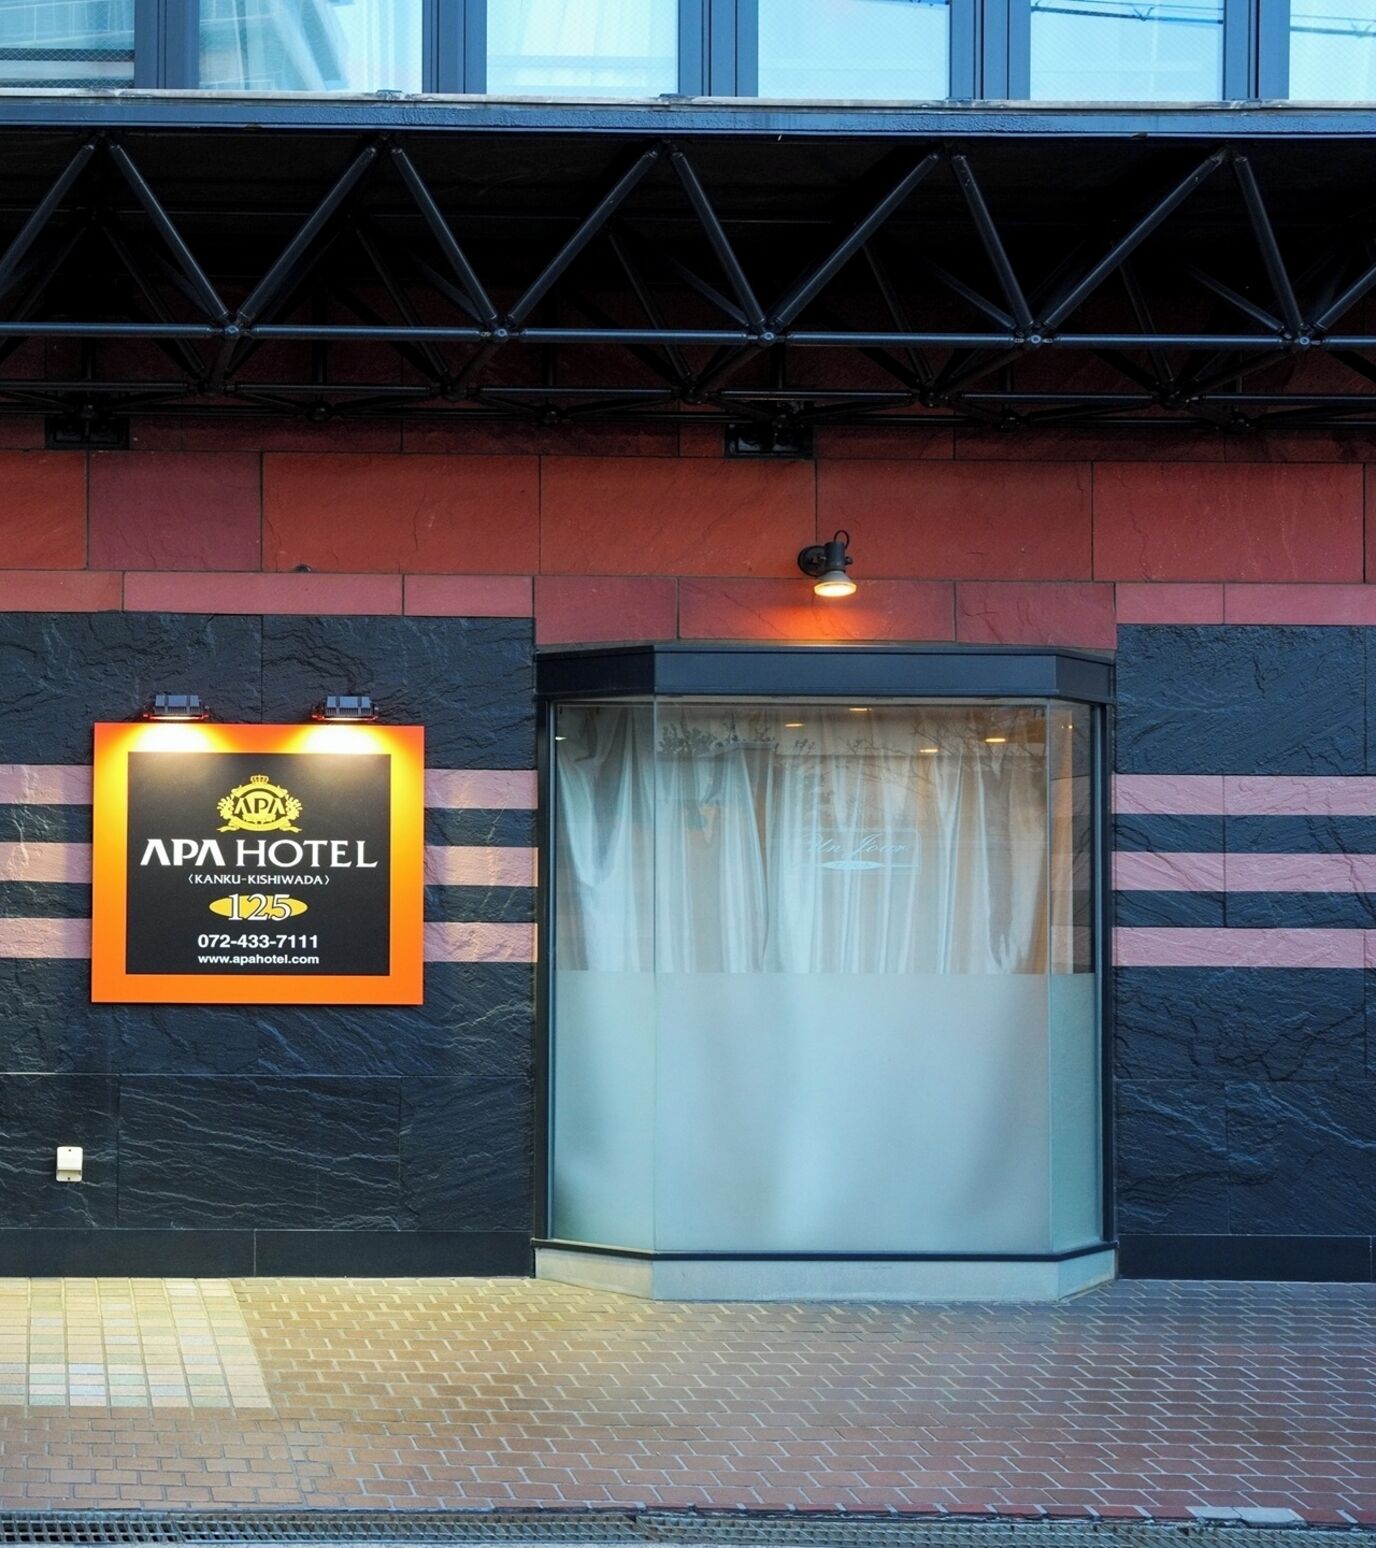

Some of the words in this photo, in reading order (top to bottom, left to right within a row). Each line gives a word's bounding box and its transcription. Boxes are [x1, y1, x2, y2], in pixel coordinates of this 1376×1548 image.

[232, 796, 287, 816] APA
[140, 838, 226, 867] APA
[236, 839, 378, 868] HOTEL
[228, 893, 293, 921] 125
[197, 933, 318, 949] 072-433-7111
[197, 953, 320, 966] www.apahotel.com
